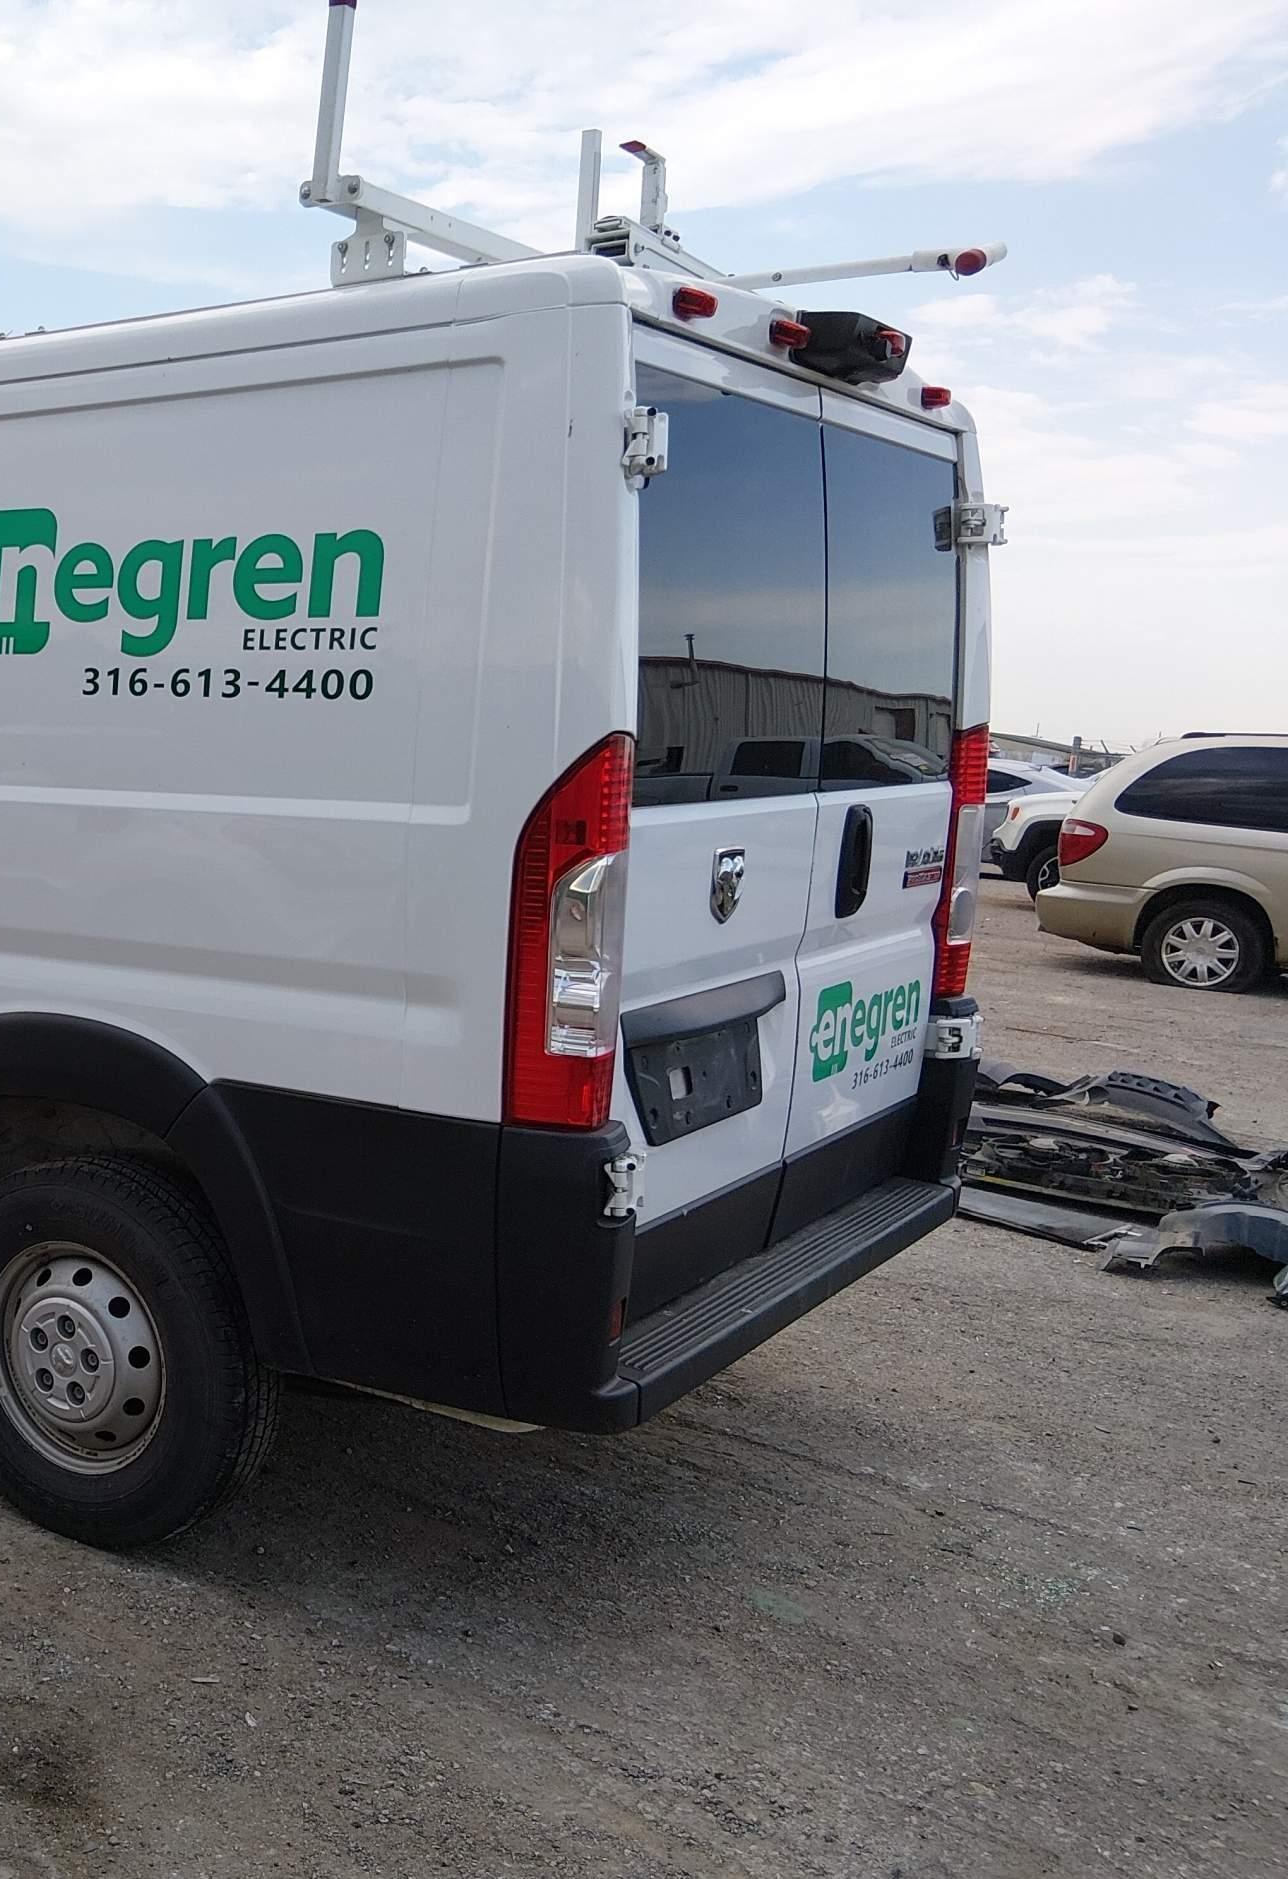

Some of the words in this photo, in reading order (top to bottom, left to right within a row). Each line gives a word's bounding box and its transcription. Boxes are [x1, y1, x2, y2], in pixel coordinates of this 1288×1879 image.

[242, 627, 379, 651] ELECTRIC
[82, 667, 375, 701] 316-613-4400
[810, 979, 922, 1061] enegren
[890, 1026, 918, 1049] ELECTRIC
[851, 1048, 915, 1090] 316-613-4400
